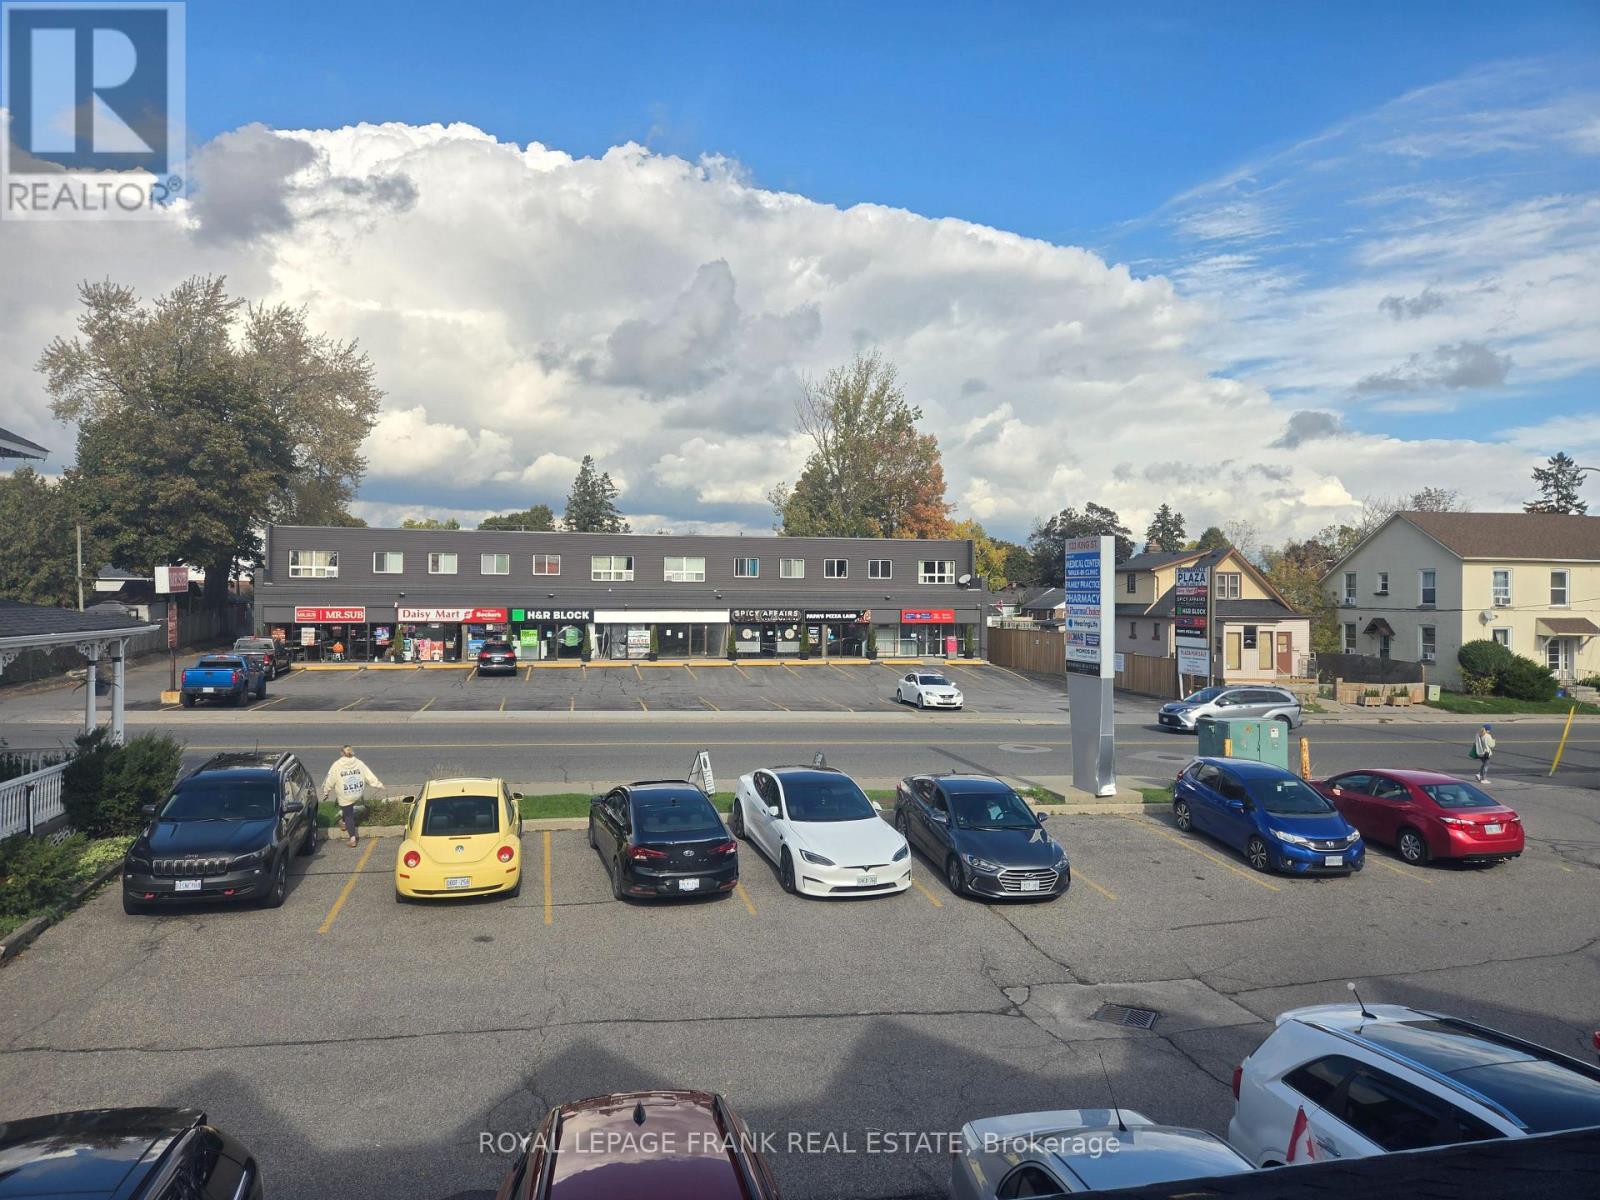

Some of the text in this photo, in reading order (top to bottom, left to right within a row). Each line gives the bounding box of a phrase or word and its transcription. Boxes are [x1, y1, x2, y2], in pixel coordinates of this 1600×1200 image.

[1066, 559, 1100, 568] MEDICAL CENTER
[1178, 573, 1206, 582] PLAZA
[1066, 580, 1100, 589] FAMILY PRACTICE
[1066, 593, 1100, 603] PHARMACY
[326, 611, 364, 619] MR.SUB
[402, 609, 460, 621] Daisy Mart
[527, 611, 589, 620] H&R BLOCK
